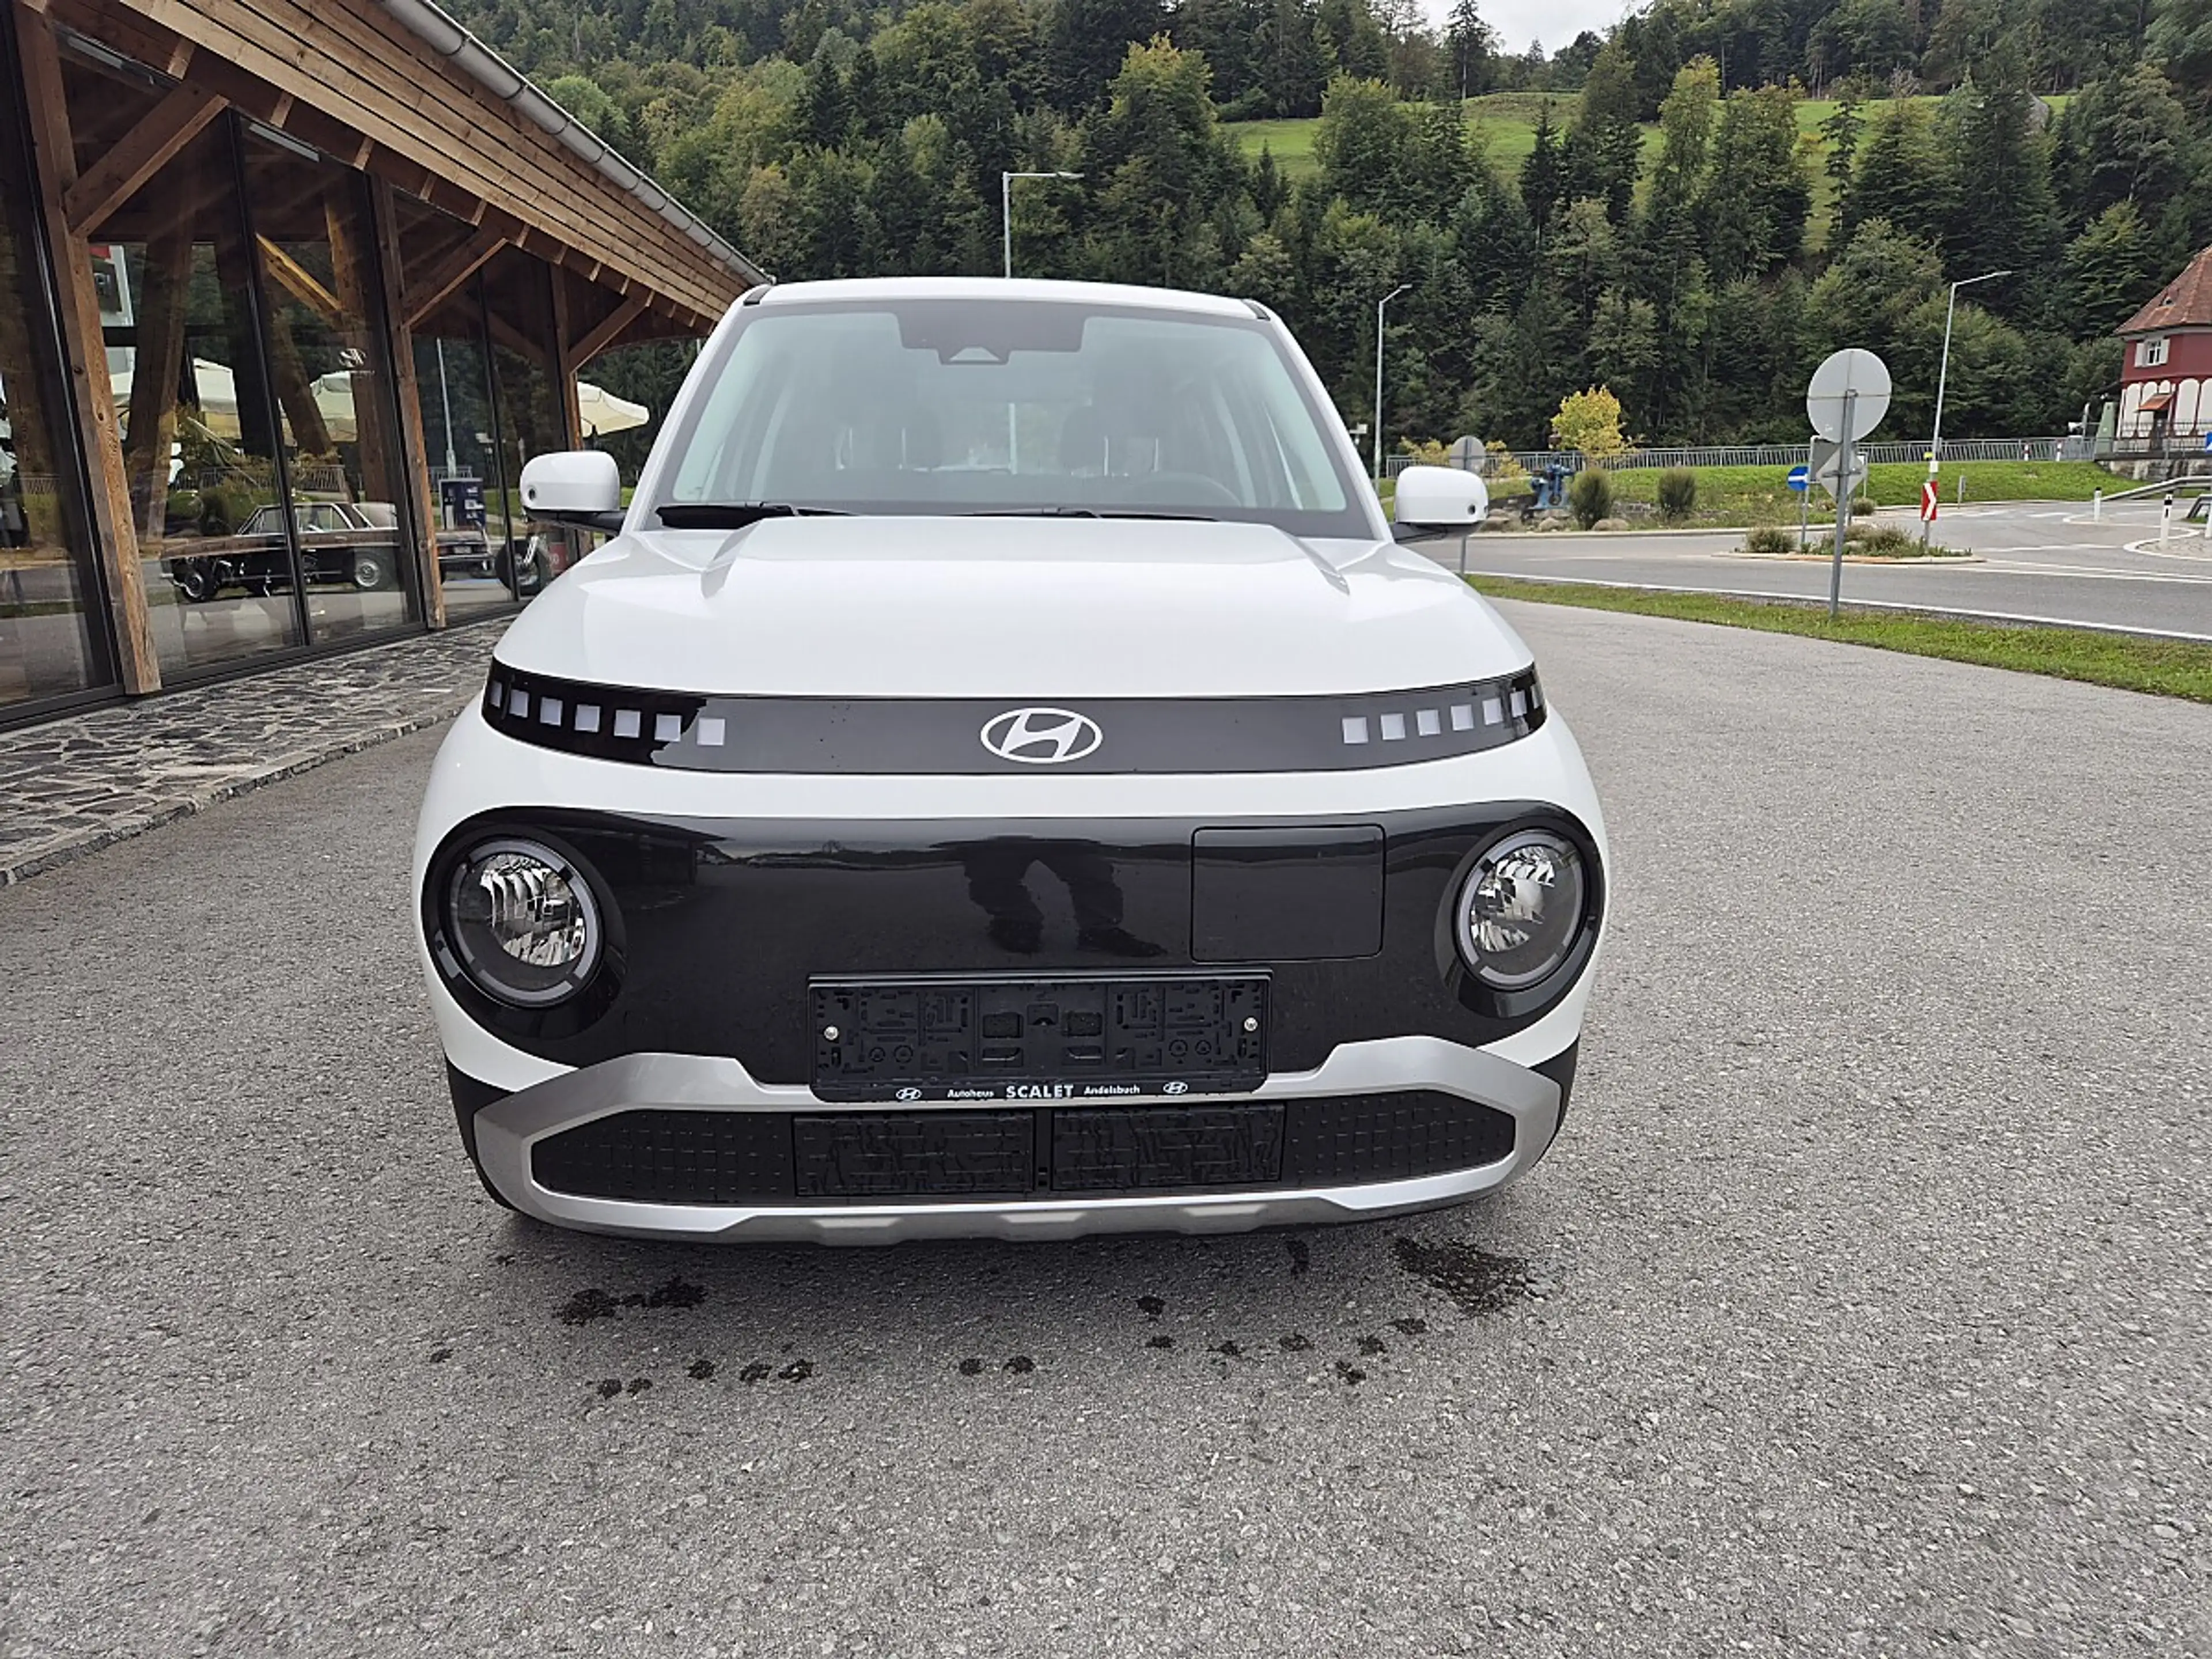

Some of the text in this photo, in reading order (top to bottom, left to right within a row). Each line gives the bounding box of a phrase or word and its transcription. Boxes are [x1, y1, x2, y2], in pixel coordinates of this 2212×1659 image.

[947, 1084, 1141, 1099] Autohaus SCALET Andelsbuch
